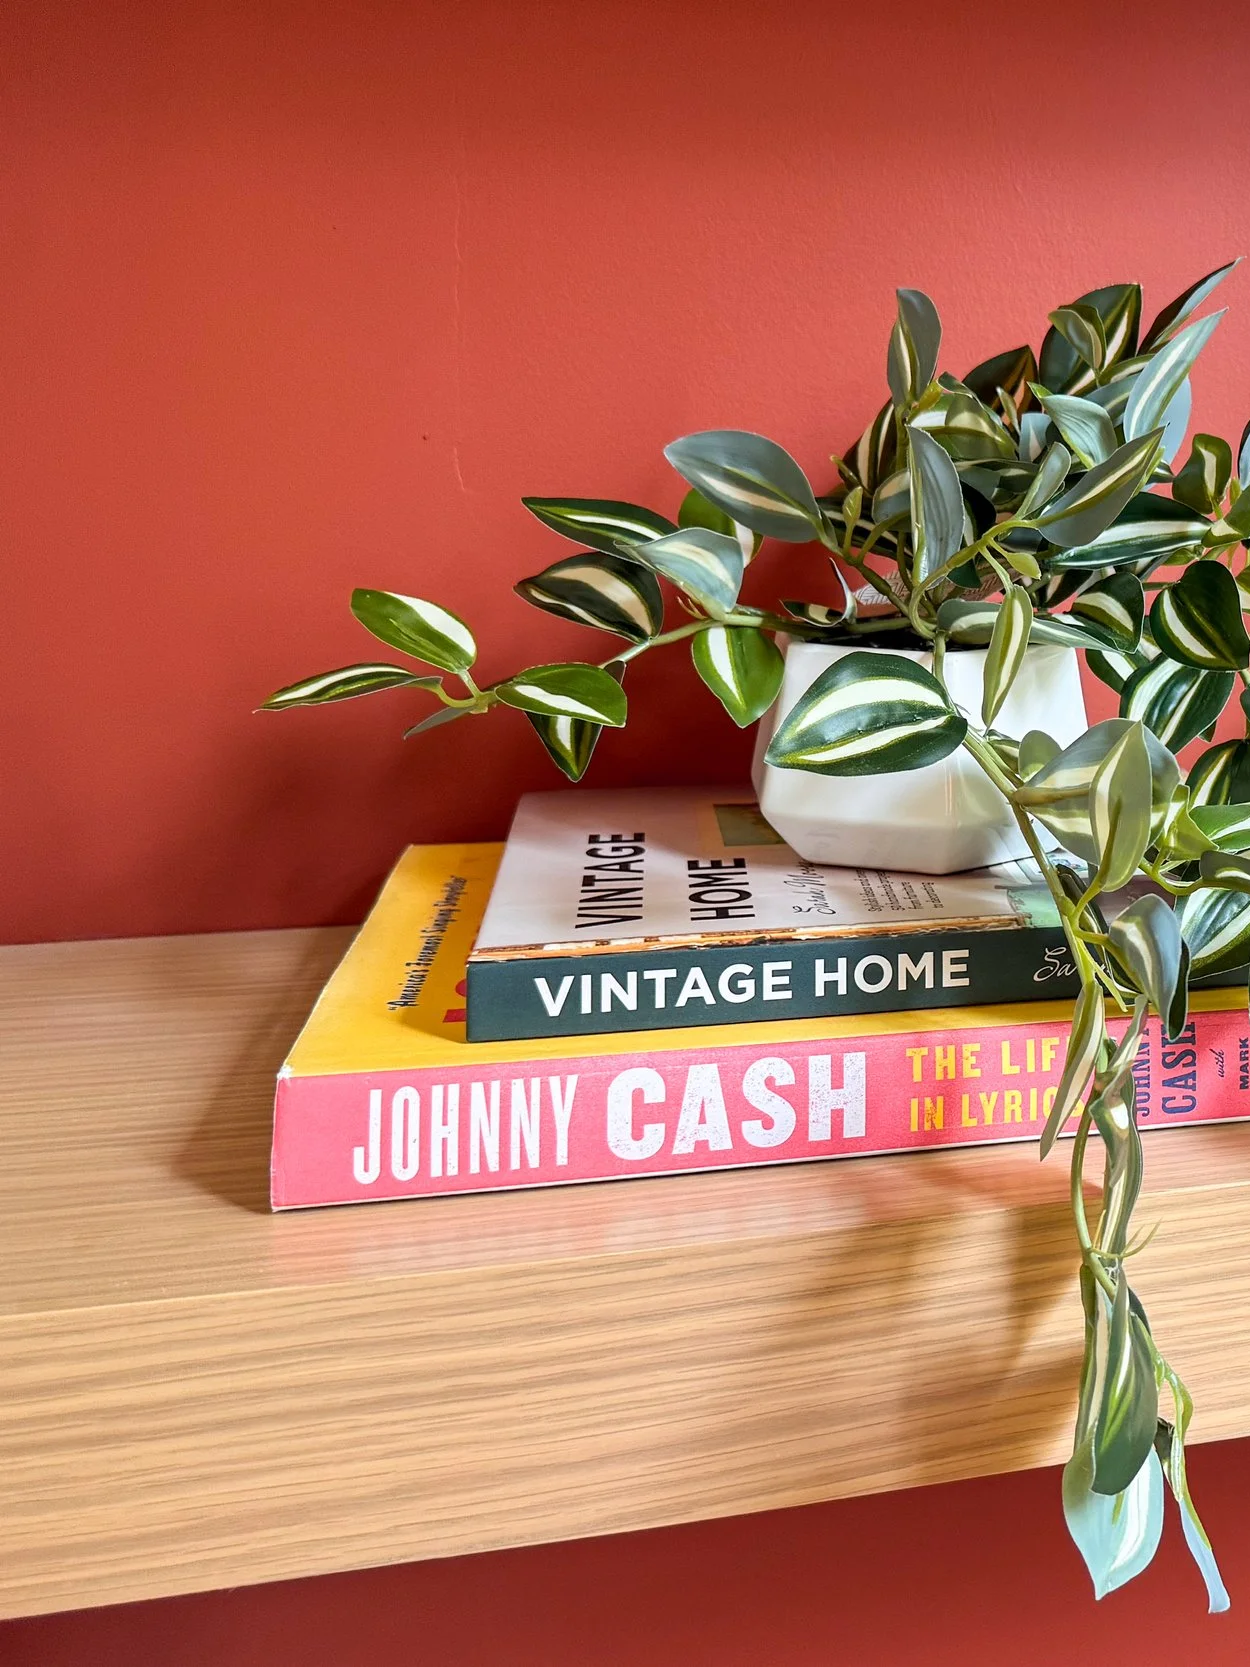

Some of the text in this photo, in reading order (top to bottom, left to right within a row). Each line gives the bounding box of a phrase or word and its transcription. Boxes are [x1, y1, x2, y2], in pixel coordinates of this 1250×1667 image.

[575, 832, 646, 929] VINTAGE
[687, 858, 755, 921] HOME
[534, 949, 970, 1017] VINTAGE HOME
[906, 1036, 1070, 1082] THE LIF
[1161, 1022, 1197, 1114] CASH
[1209, 1048, 1225, 1078] with
[1239, 1037, 1249, 1090] MARK
[353, 1052, 866, 1185] JOHNNY CASH
[910, 1095, 944, 1132] IN
